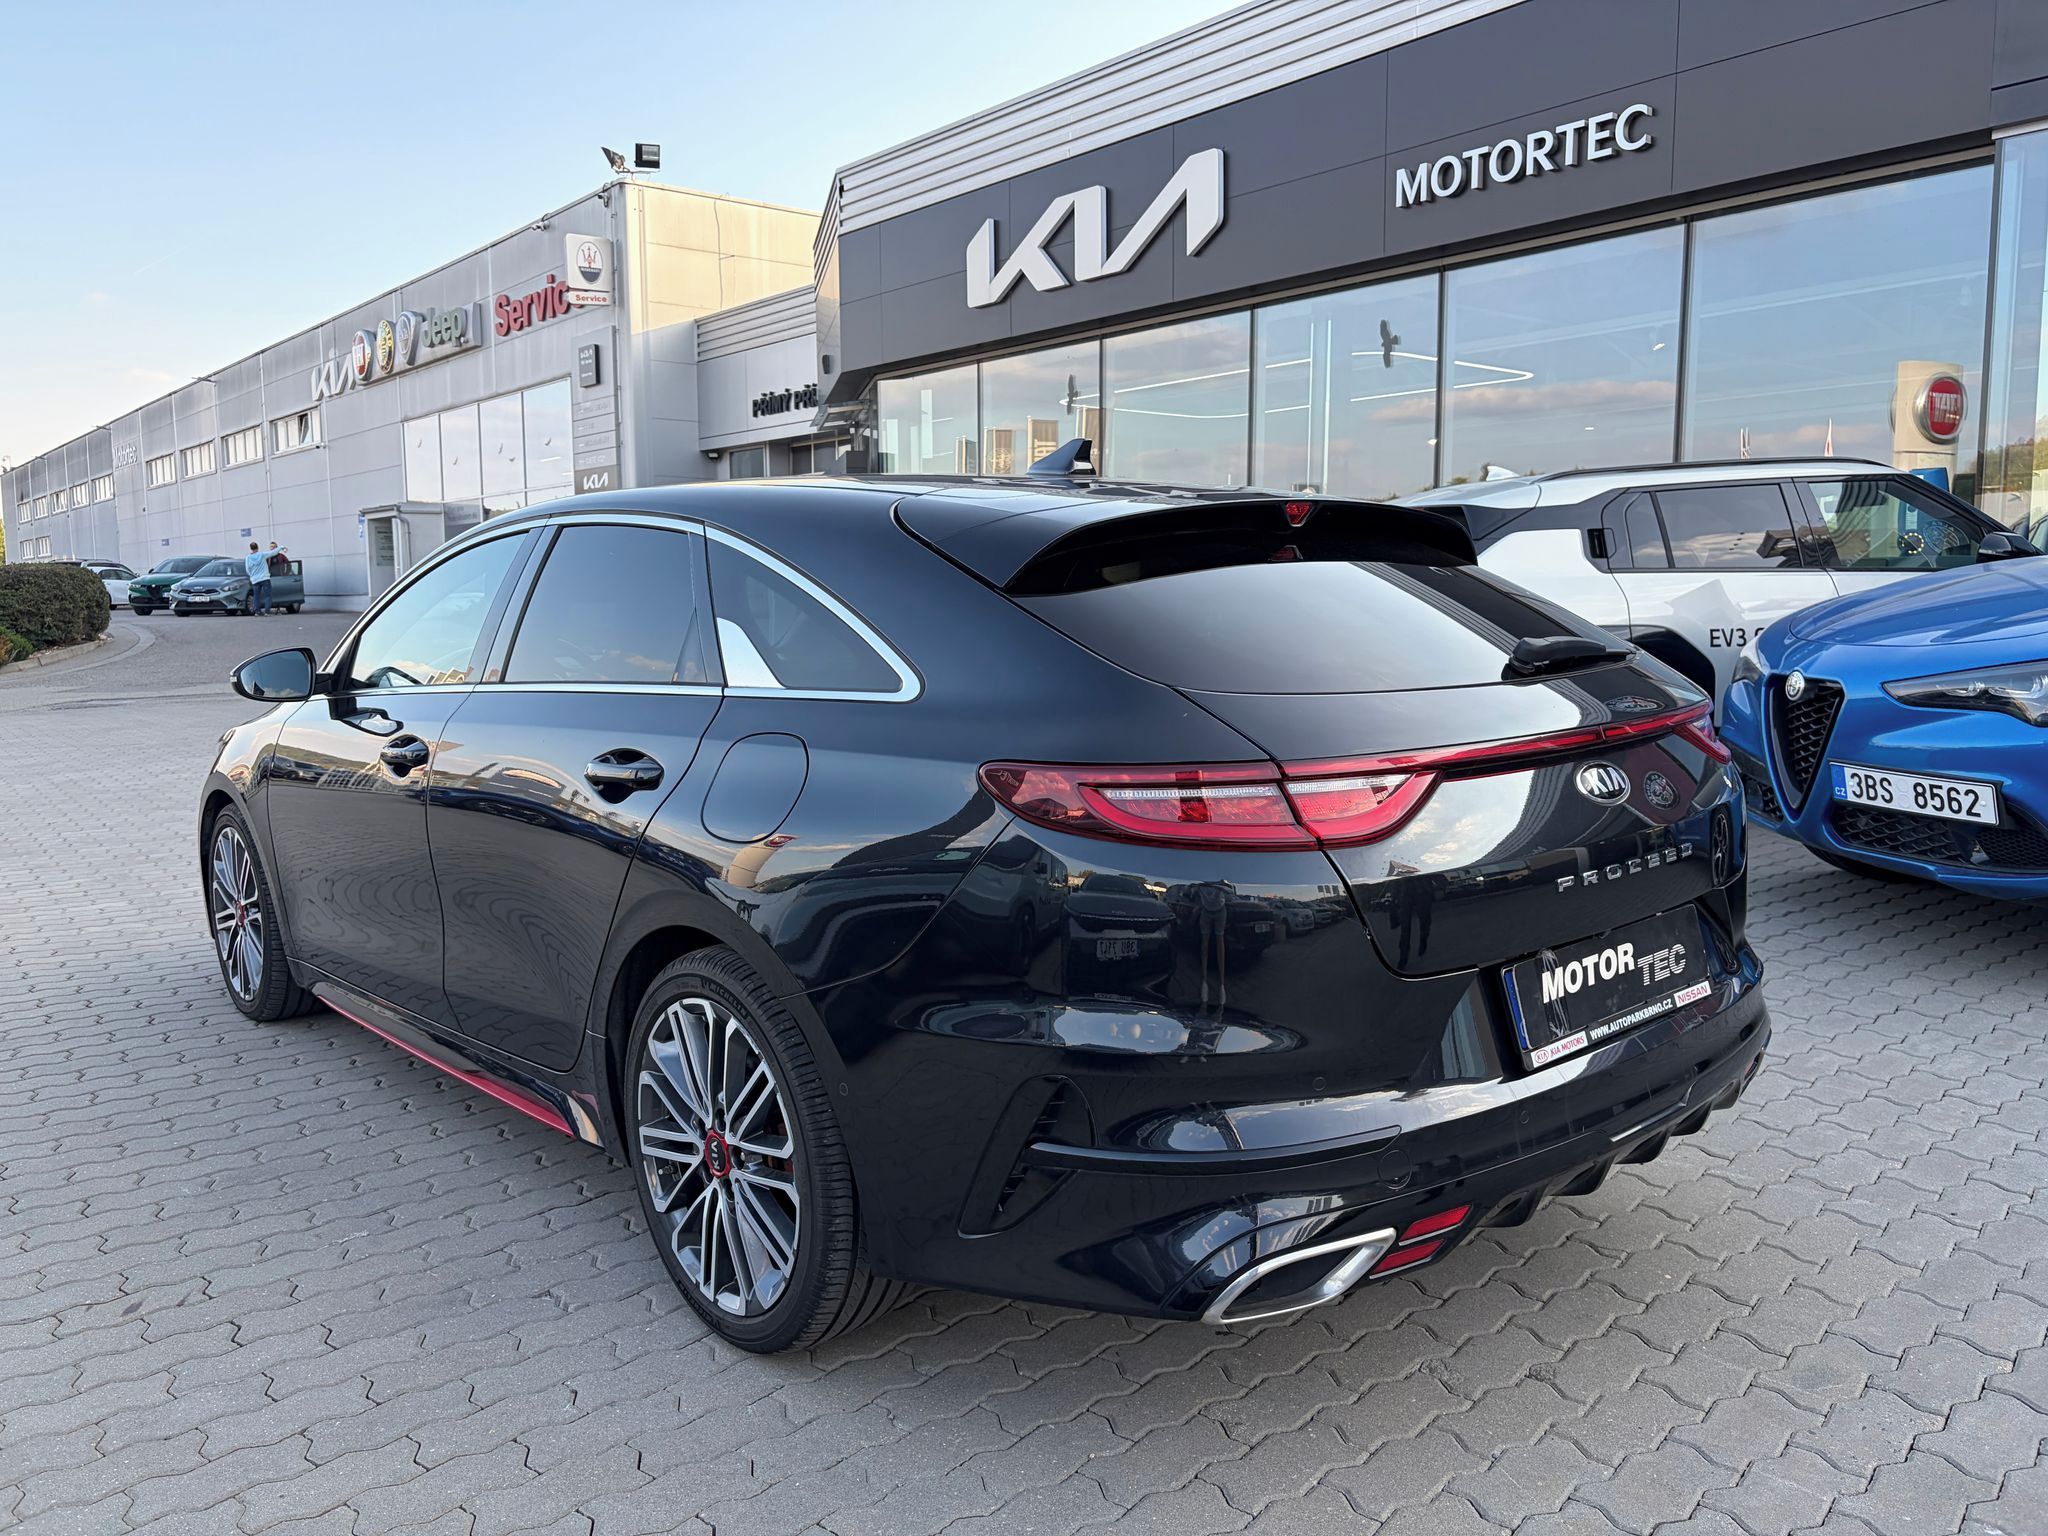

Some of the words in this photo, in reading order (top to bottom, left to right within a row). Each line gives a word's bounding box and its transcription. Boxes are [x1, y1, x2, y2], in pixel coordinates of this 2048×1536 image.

[1395, 103, 1653, 208] MOTORTEC
[966, 148, 1225, 308] KIA
[495, 274, 585, 337] Servic
[575, 294, 608, 303] Service
[420, 307, 467, 348] Jeep
[752, 388, 793, 418] PŘÍMÝ
[794, 382, 818, 410] PŘÍ
[583, 472, 608, 490] KIA
[1709, 628, 1747, 647] EV3
[1582, 767, 1626, 796] KIA
[1834, 786, 1846, 796] CZ
[1850, 772, 1894, 804] 3BS
[1912, 782, 1981, 818] 8562
[1556, 842, 1693, 893] PROCEED
[1541, 942, 1636, 1004] MOTOR
[1637, 943, 1687, 987] TEC
[1677, 985, 1709, 1004] NISSAN
[1589, 998, 1674, 1040] WWW.AUTOPARKBRNO.CZ
[1550, 1045, 1561, 1057] KIA
[1561, 1036, 1585, 1051] MOTORS
